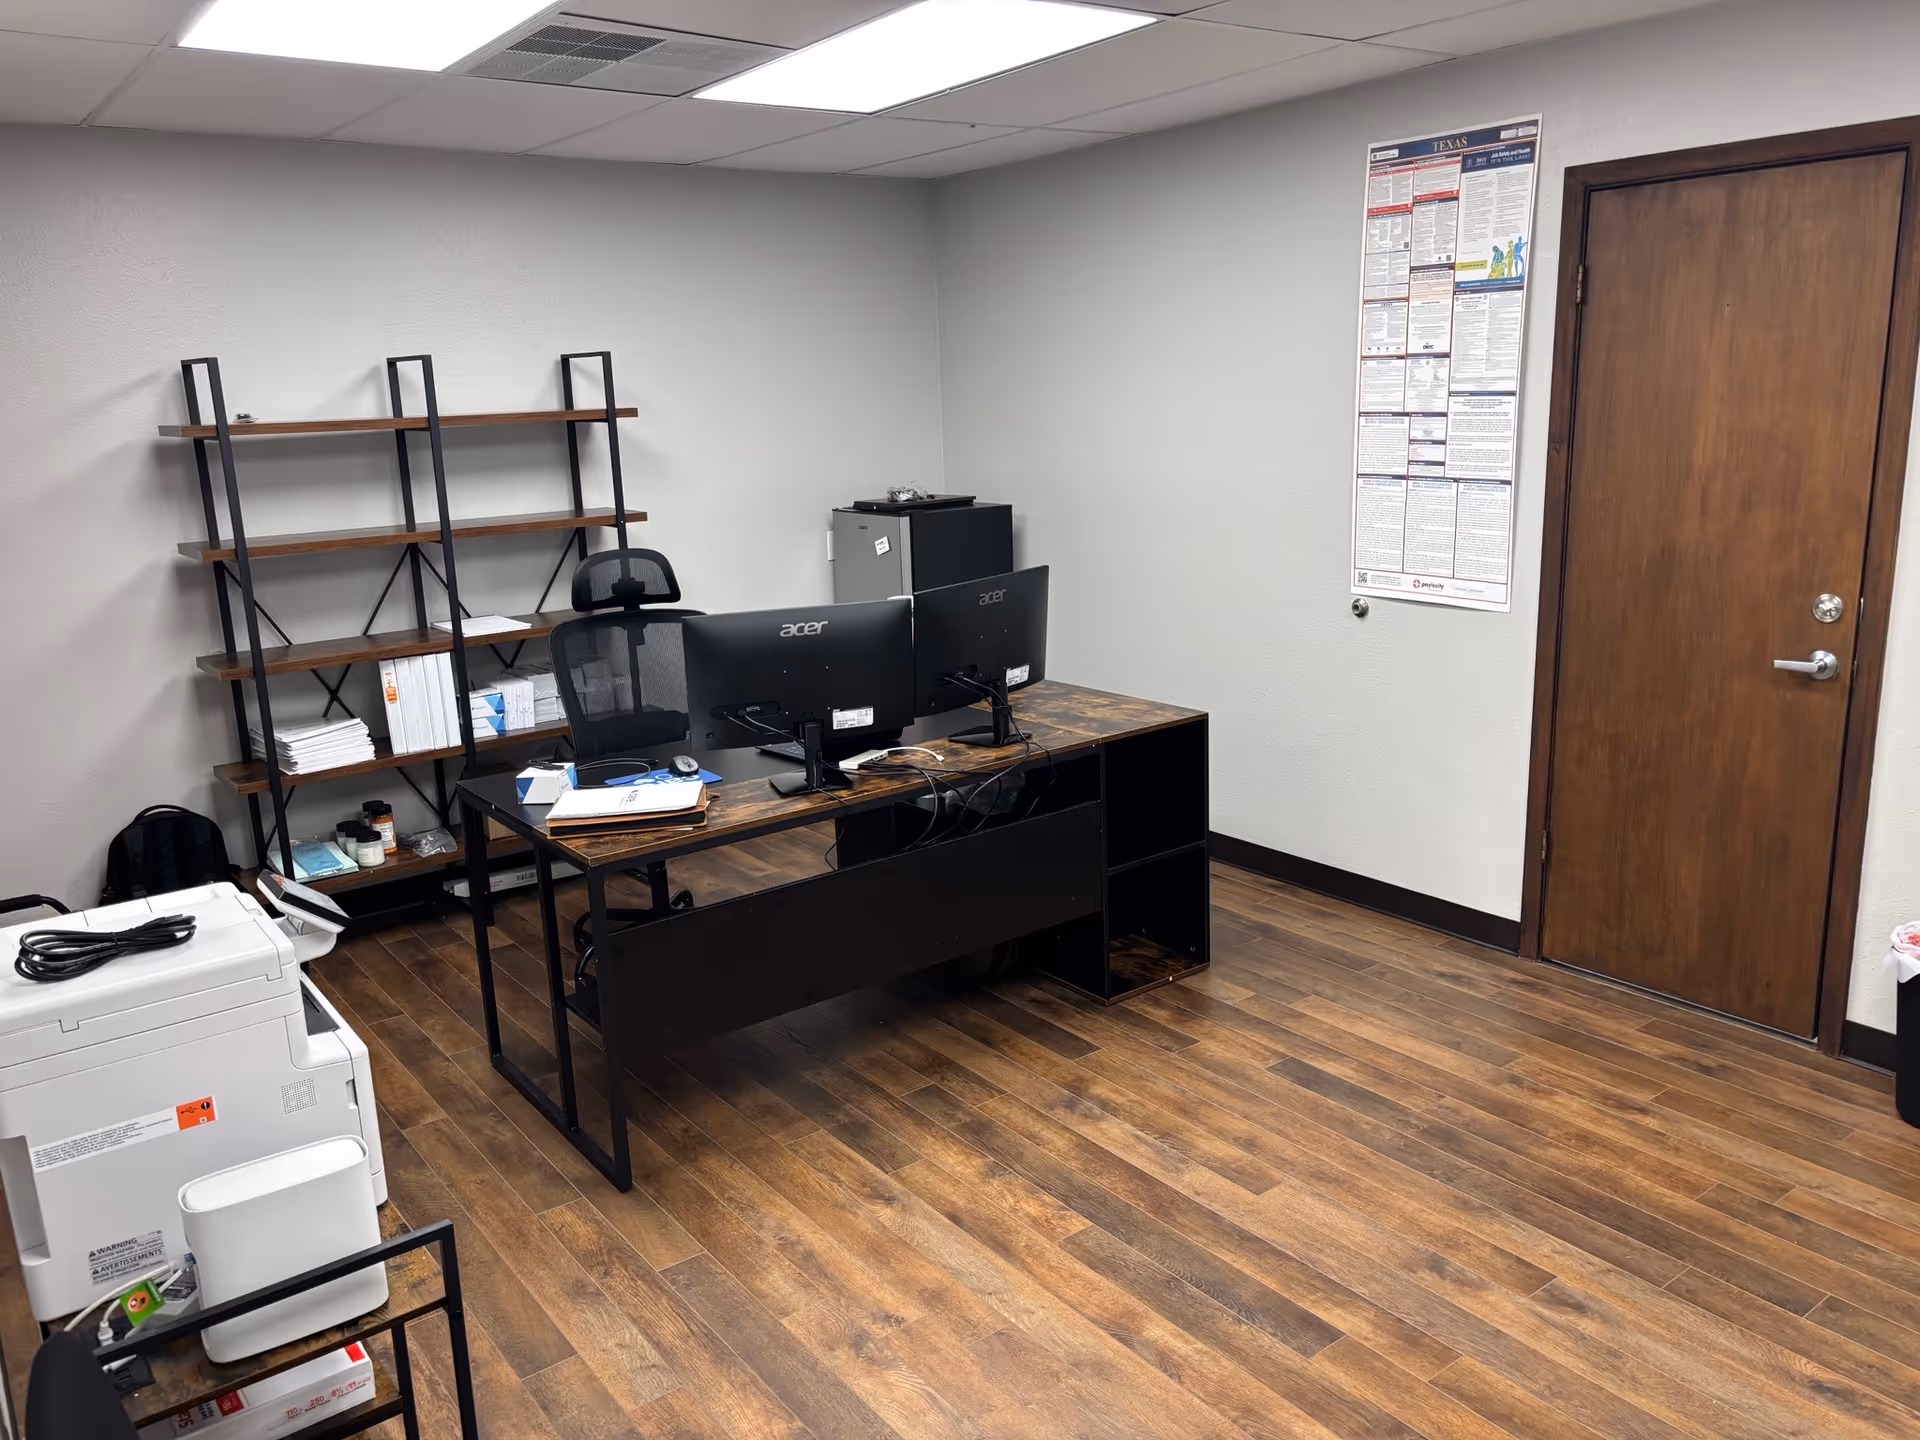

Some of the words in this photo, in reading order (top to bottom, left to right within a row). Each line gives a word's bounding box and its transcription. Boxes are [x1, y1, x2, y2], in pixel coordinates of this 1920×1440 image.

[1432, 136, 1467, 152] TEXAS
[1422, 582, 1444, 590] paylocity
[979, 589, 1006, 606] acer
[780, 620, 828, 638] acer
[97, 1237, 138, 1254] WARNING
[100, 1248, 162, 1272] AVERTISSEMENTS
[309, 1396, 324, 1406] 250
[286, 1407, 298, 1416] 110
